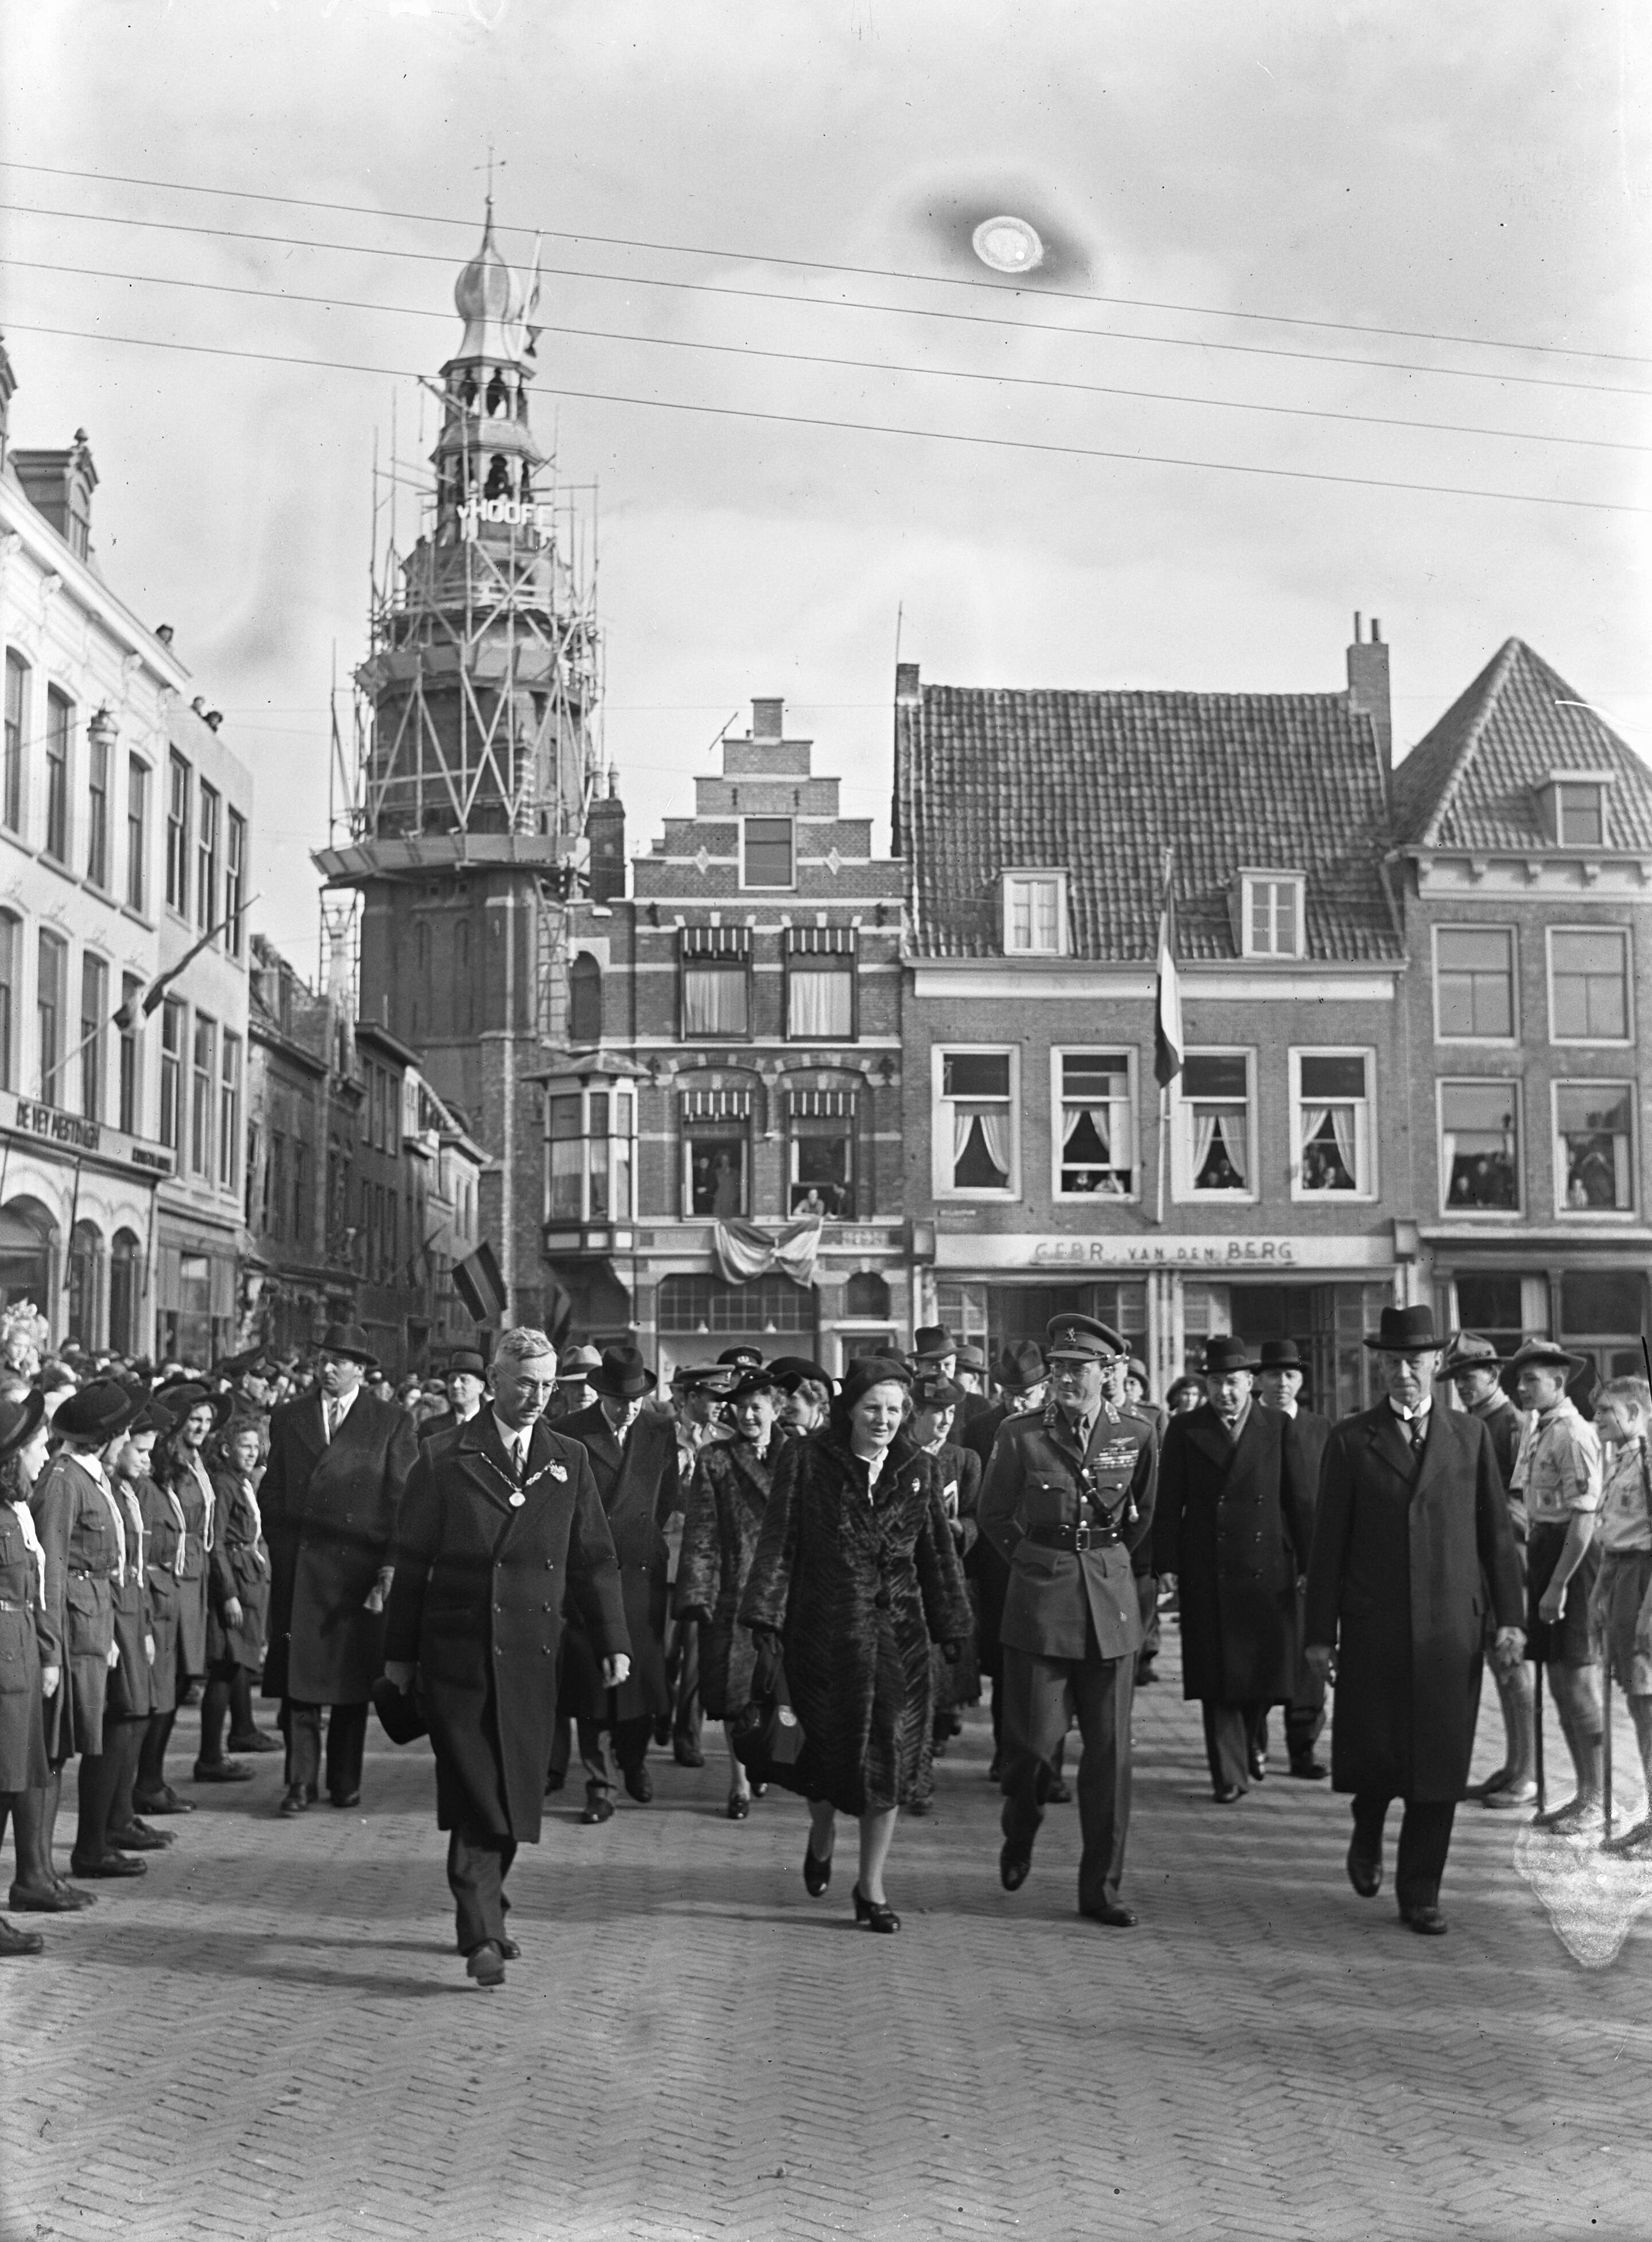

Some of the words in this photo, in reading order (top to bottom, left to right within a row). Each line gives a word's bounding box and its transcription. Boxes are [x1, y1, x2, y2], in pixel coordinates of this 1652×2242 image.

[1127, 1247, 1164, 1260] VAN
[1177, 1247, 1214, 1260] DEN
[1228, 1241, 1292, 1259] BERG
